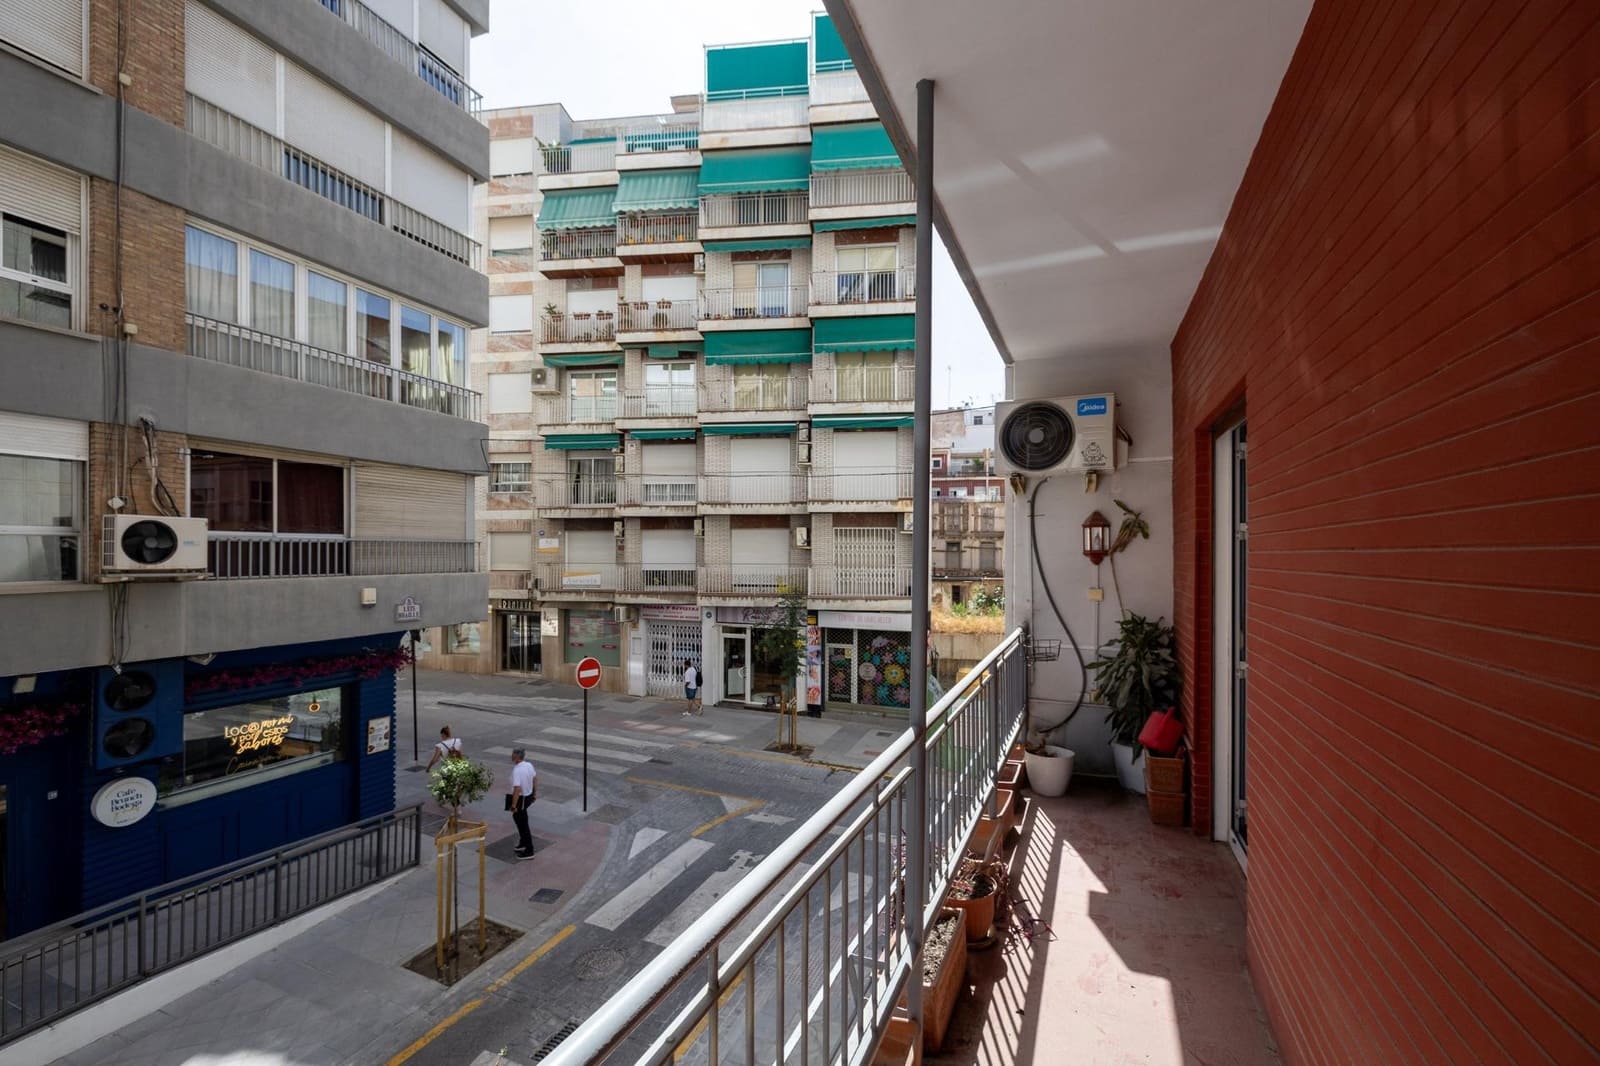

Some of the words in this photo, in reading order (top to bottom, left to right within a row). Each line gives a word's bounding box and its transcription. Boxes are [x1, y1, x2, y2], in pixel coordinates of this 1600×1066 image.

[231, 736, 238, 746] y
[236, 732, 284, 755] sabores
[111, 793, 143, 806] Brunch
[111, 800, 143, 813] Bodega
